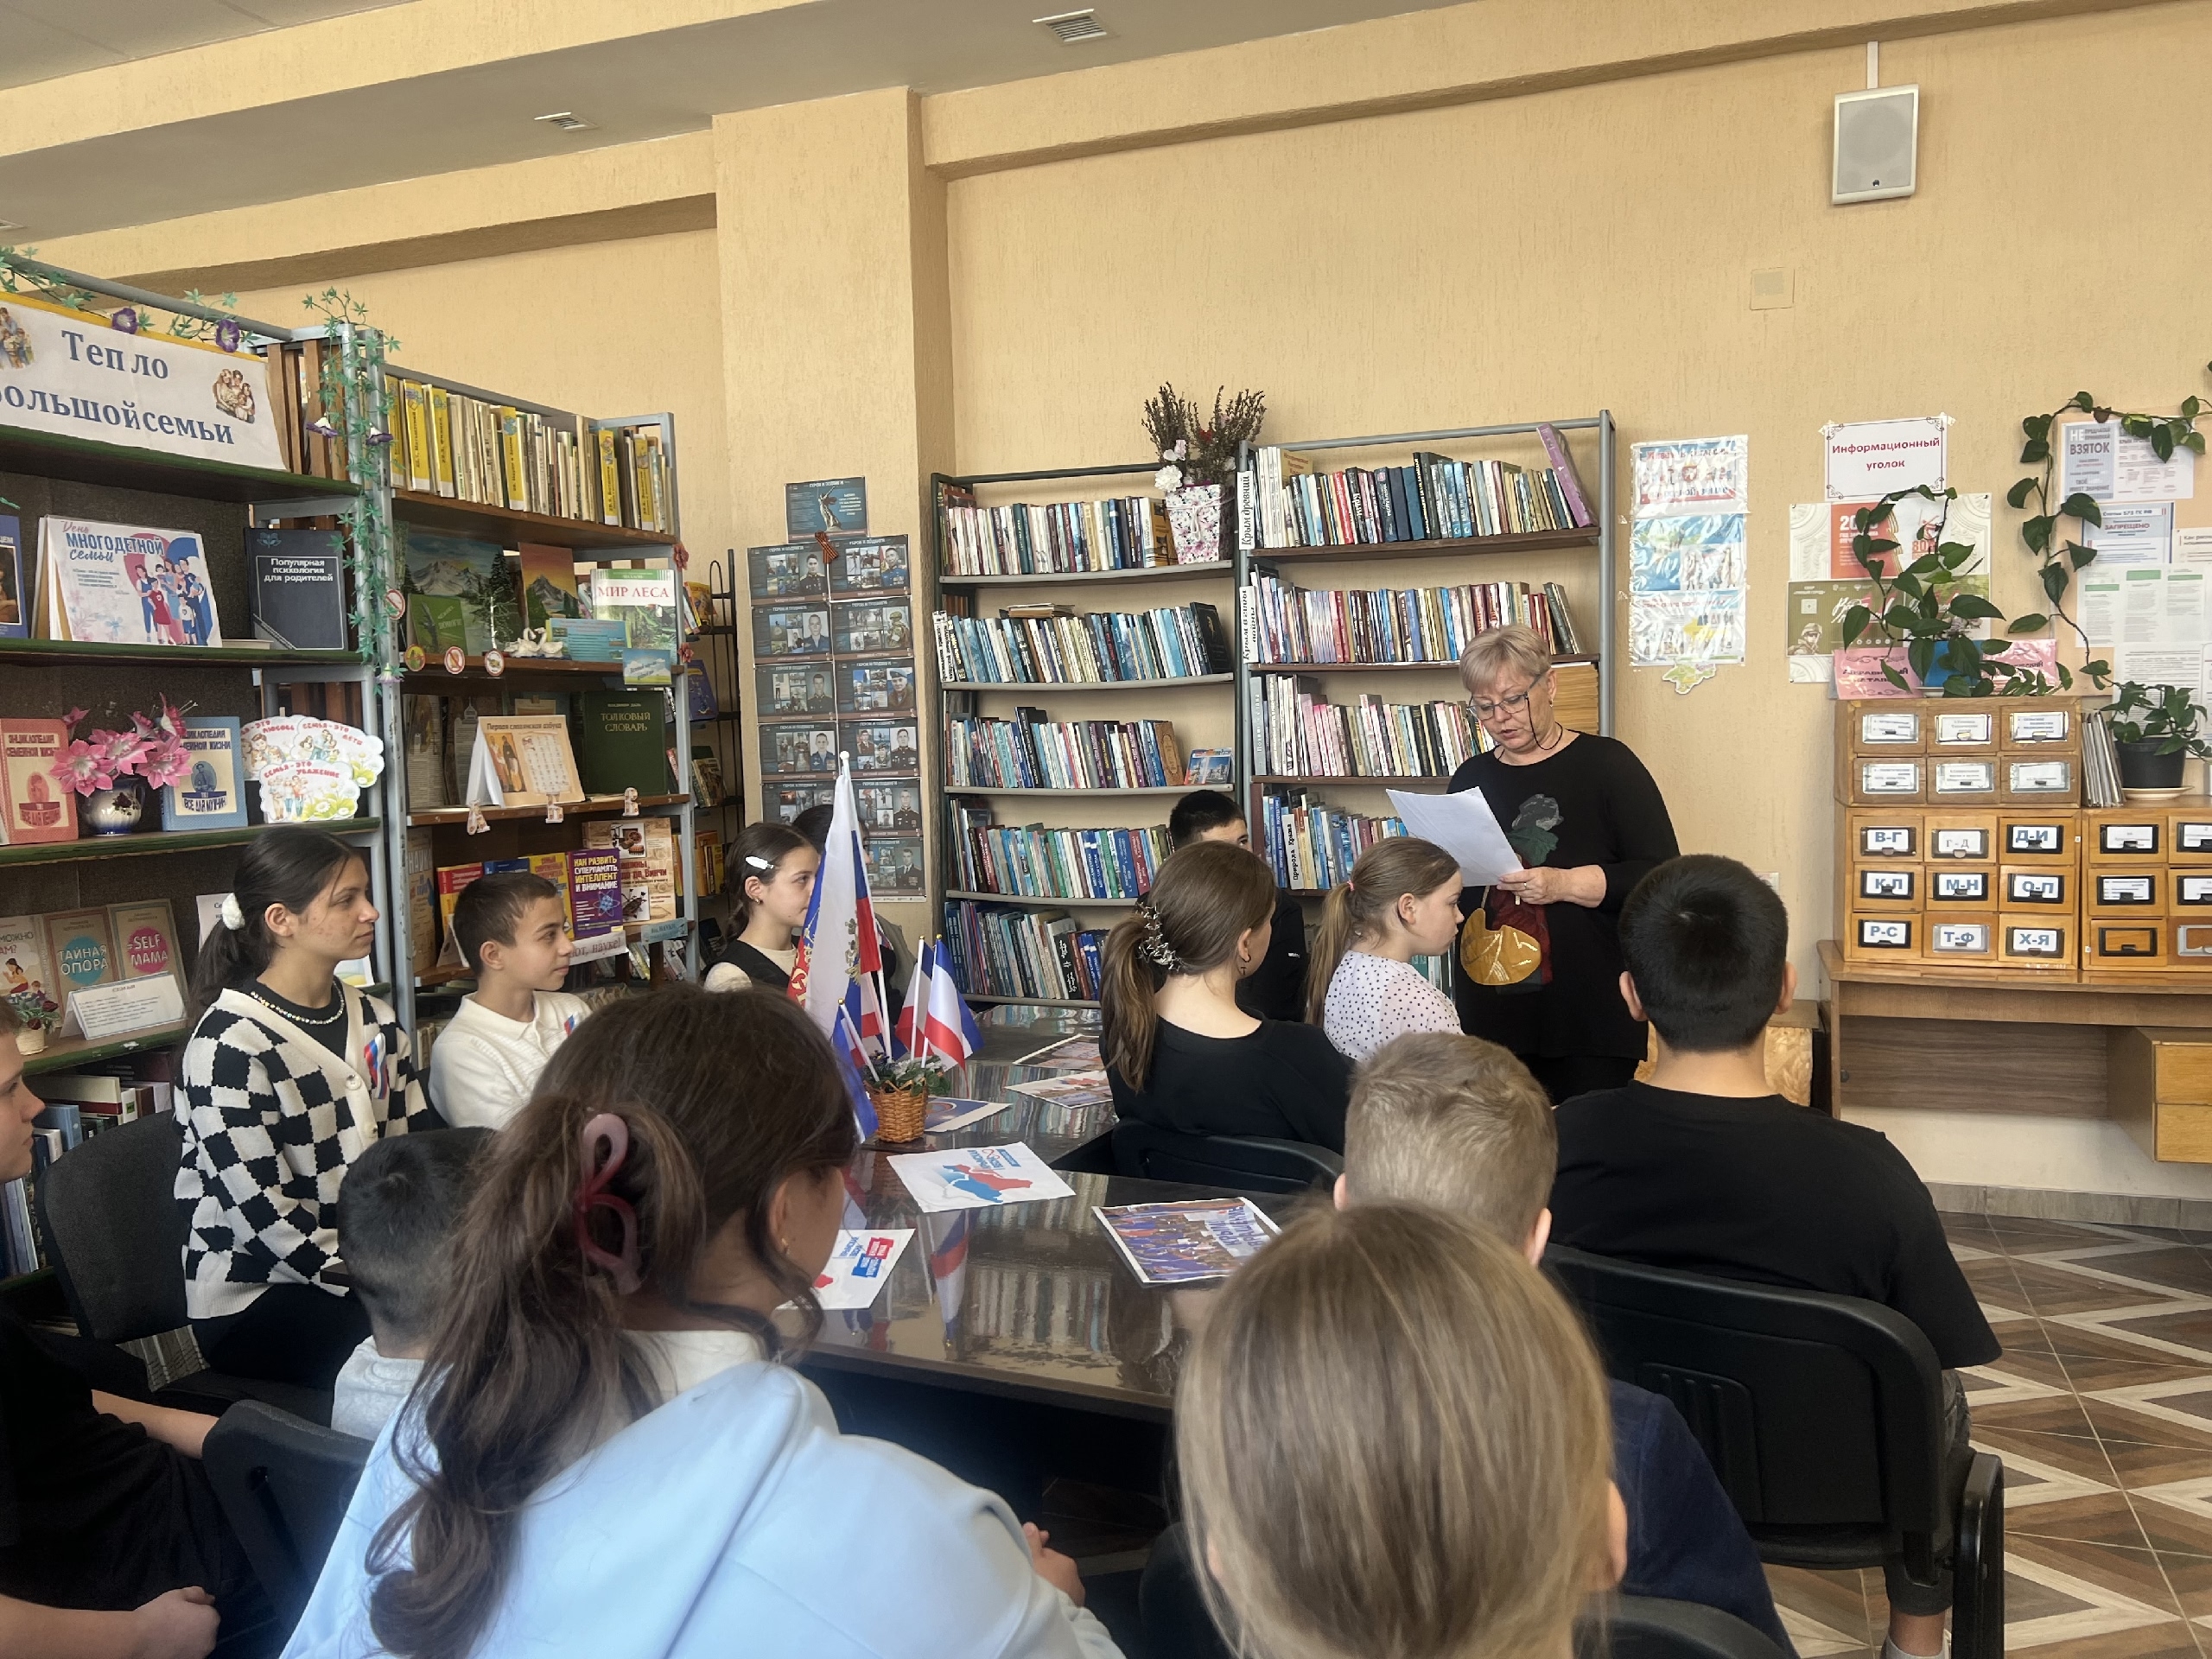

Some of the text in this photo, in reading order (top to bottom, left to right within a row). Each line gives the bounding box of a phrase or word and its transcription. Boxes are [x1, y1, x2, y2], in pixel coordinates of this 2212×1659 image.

[61, 330, 168, 379] Тепло
[1832, 437, 1940, 454] Информационный
[2069, 442, 2110, 455] ВЗЯТОК
[1866, 460, 1905, 471] уголок
[1240, 474, 1253, 545] Крым древний
[65, 531, 165, 556] МНОГОДЕТНОЙ
[270, 558, 325, 568] Популярная
[284, 573, 334, 583] родителей
[597, 586, 670, 598] МИР ЛЕСА
[601, 711, 651, 721] ТОЛКОВЫЙ
[605, 722, 648, 732] СЛОВАРЬ
[1875, 831, 1902, 842] В-Г
[2015, 830, 2049, 843] Д-И
[1287, 823, 1300, 880] Природа Крыма
[588, 855, 618, 866] РАЗВИТЬ
[575, 872, 618, 883] ИНТЕЛЛЕКТ
[582, 881, 619, 891] ВНИМАНИЕ
[1875, 878, 1903, 890] К-Л
[1946, 879, 1979, 890] М-Н
[2022, 880, 2054, 893] О-П
[1870, 925, 1897, 938] Р-С
[1943, 931, 1975, 943] Т-Ф
[2019, 933, 2050, 946] Х-Я
[57, 944, 106, 961] ТАЙНАЯ
[60, 957, 110, 976] ОПОРА
